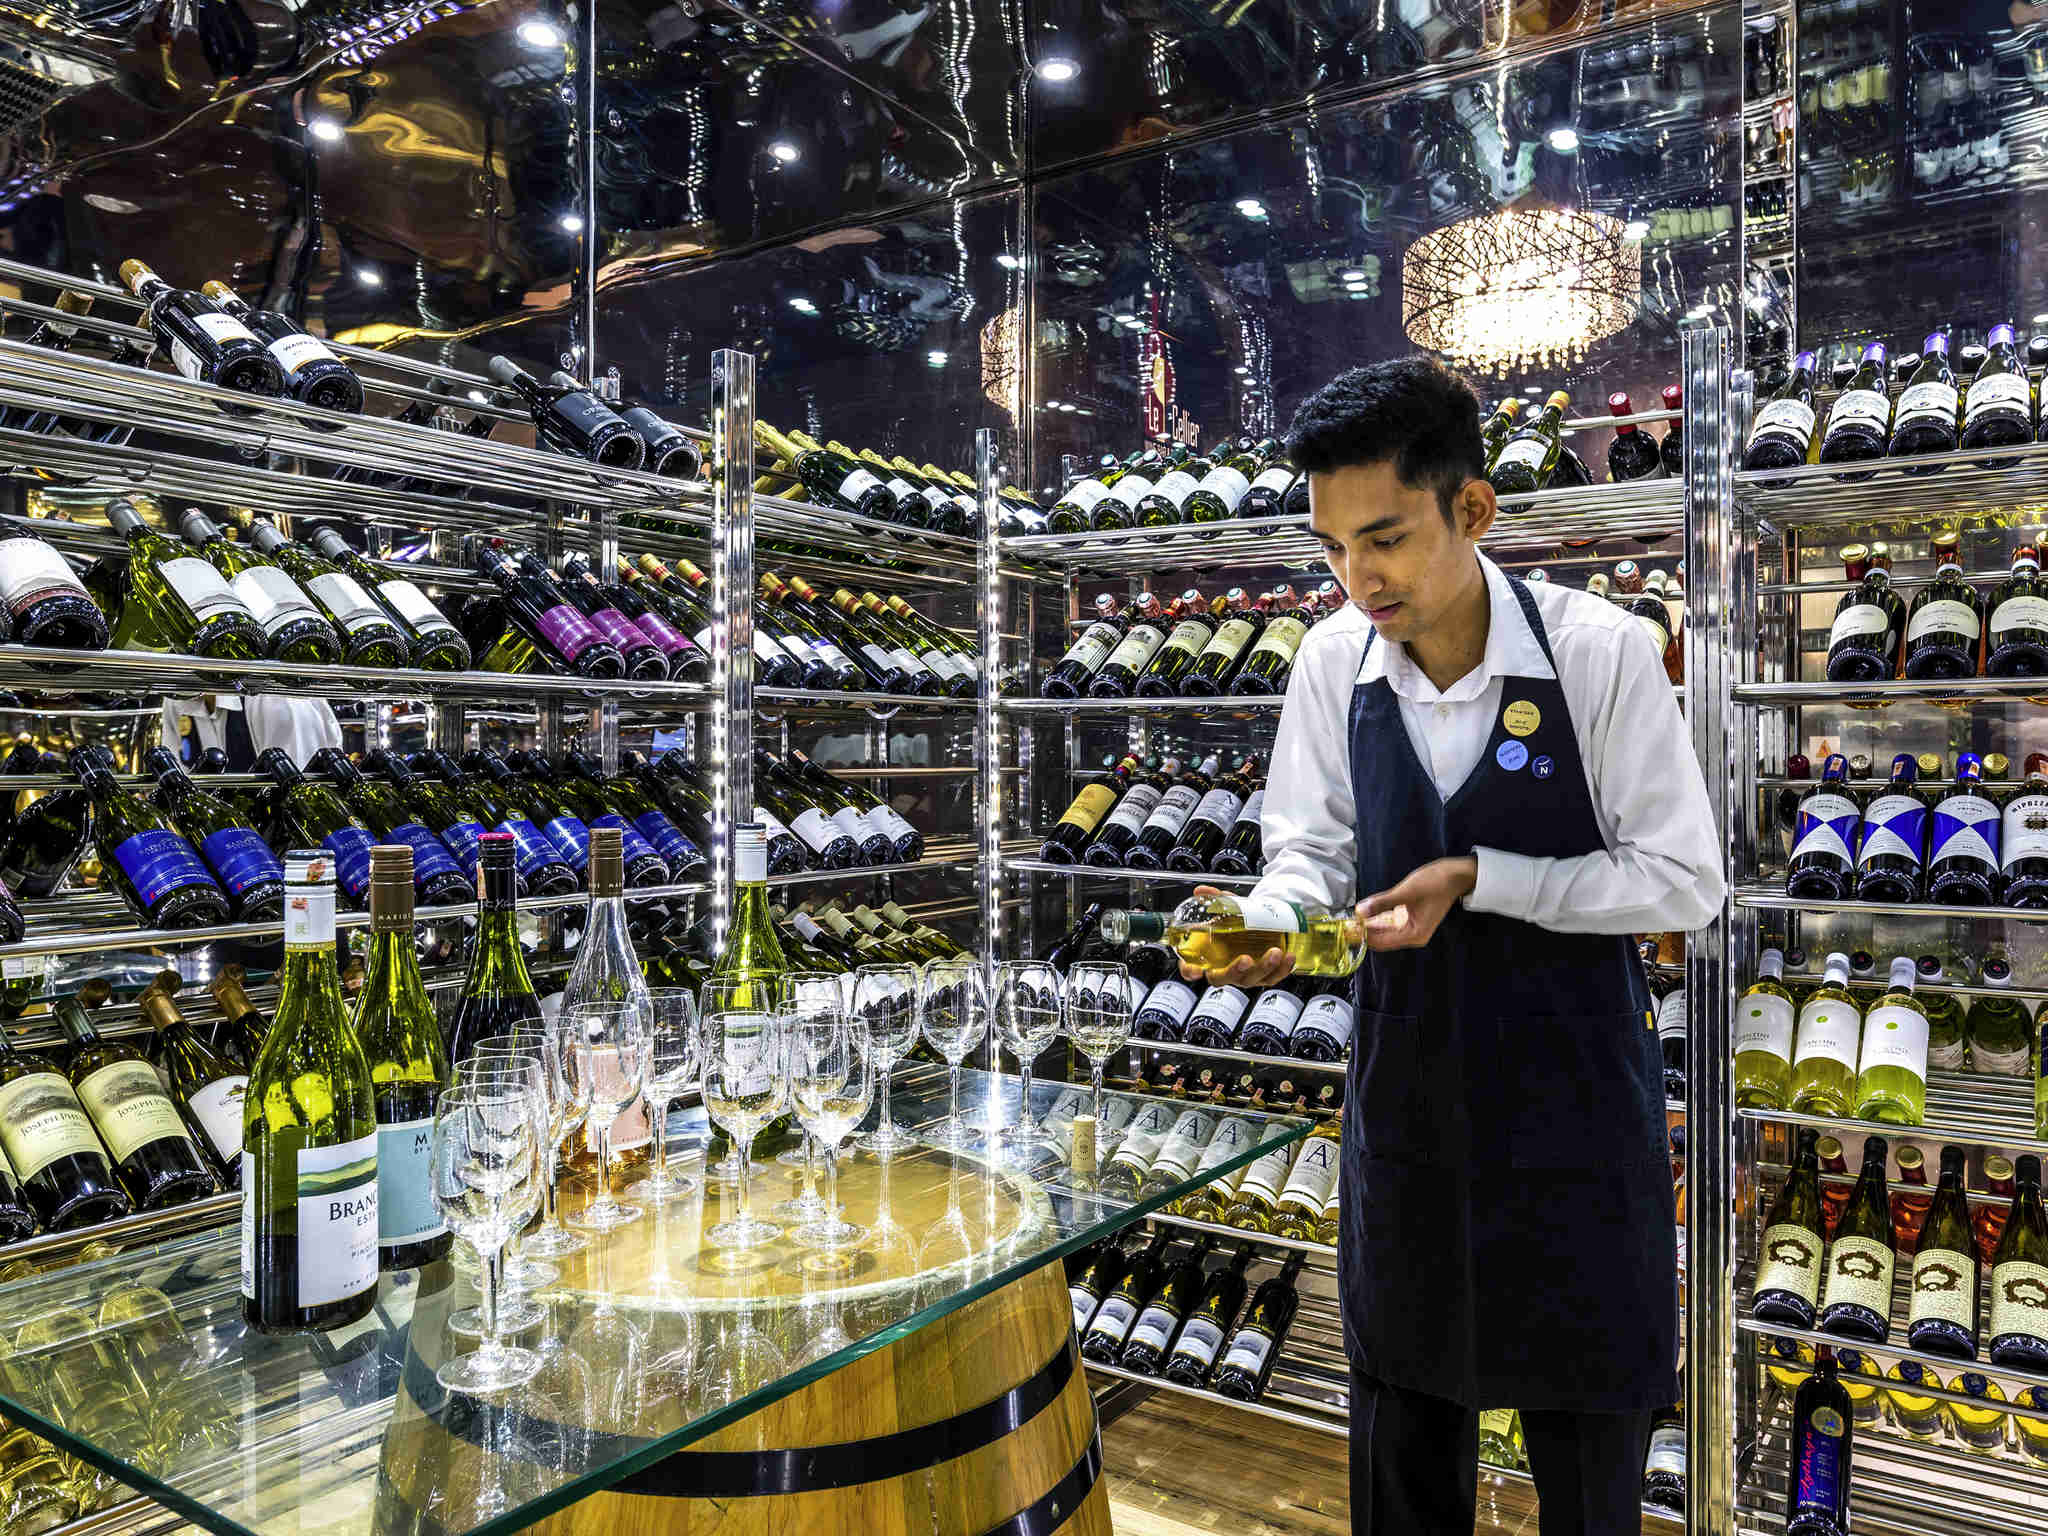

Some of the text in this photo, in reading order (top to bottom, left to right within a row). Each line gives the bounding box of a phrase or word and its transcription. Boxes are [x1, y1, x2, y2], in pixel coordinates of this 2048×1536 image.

[1148, 394, 1160, 433] Le
[1172, 404, 1200, 449] Cellier
[1540, 766, 1549, 775] N
[20, 1114, 58, 1137] JOSEPH
[1137, 1108, 1159, 1129] A
[1176, 1116, 1198, 1140] A
[1216, 1122, 1237, 1145] A
[1304, 1142, 1327, 1169] A
